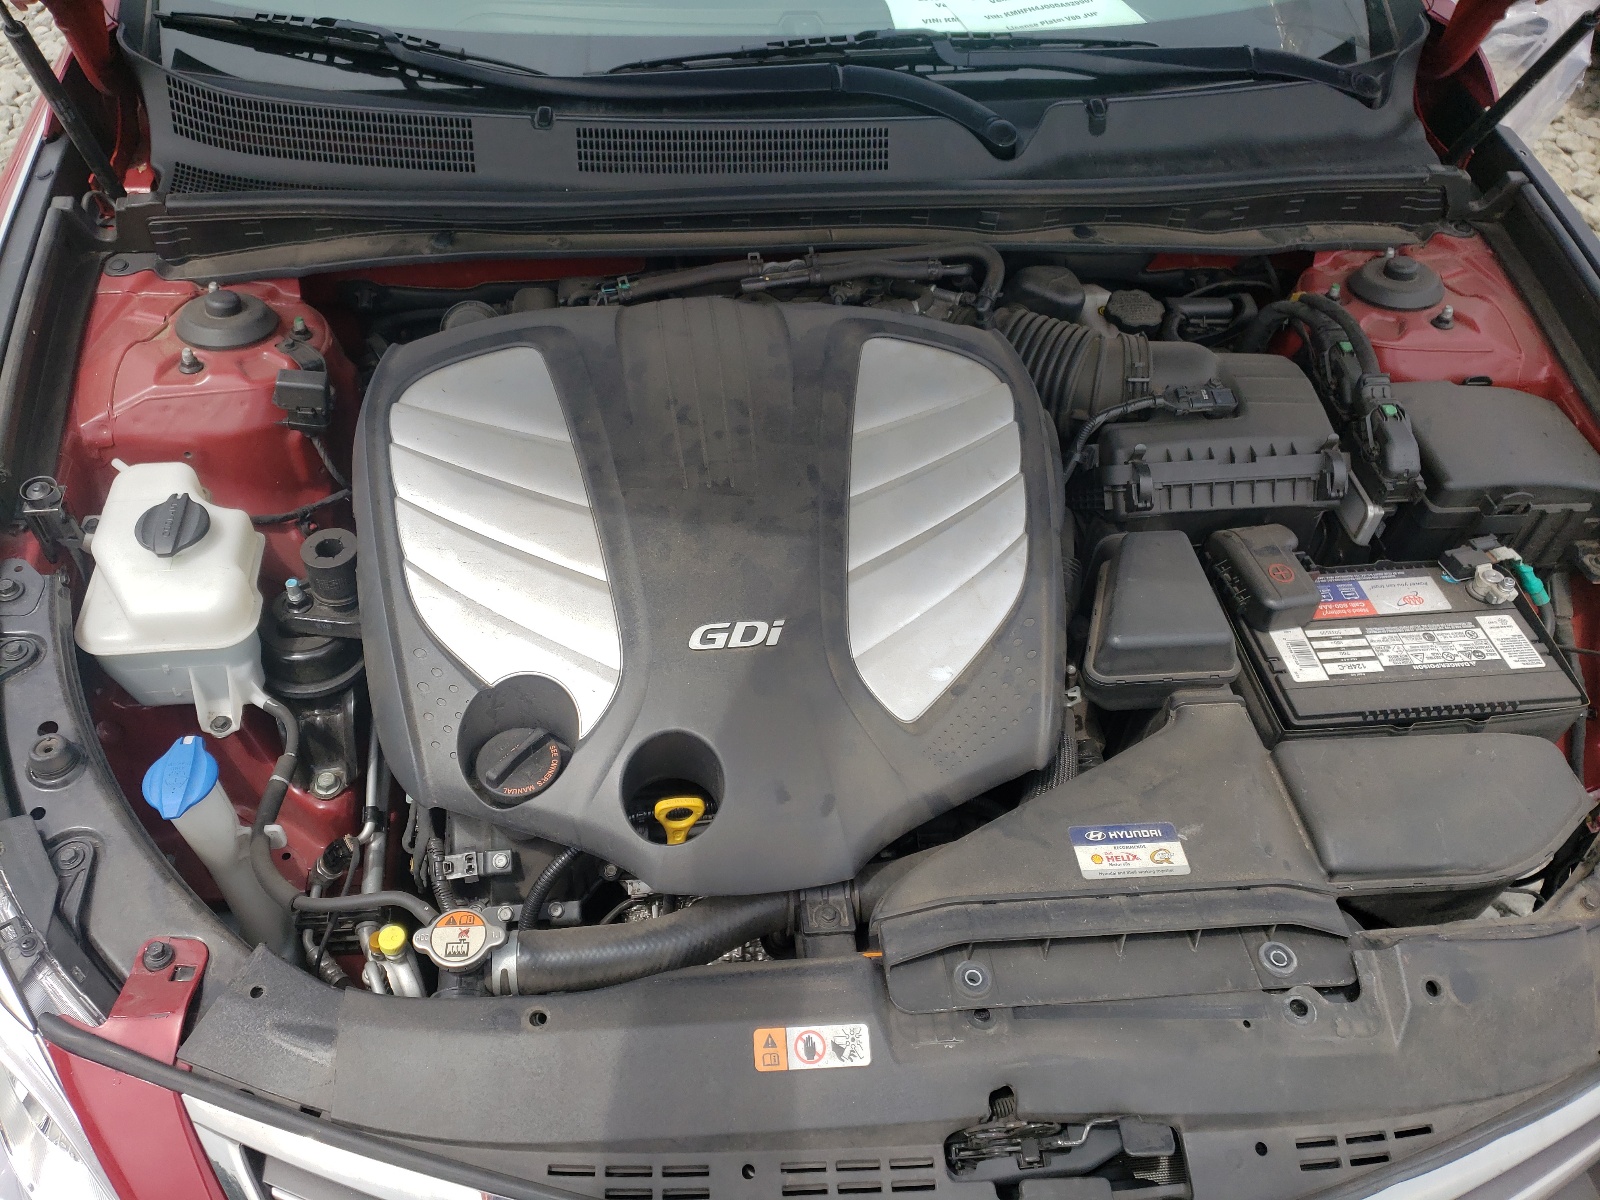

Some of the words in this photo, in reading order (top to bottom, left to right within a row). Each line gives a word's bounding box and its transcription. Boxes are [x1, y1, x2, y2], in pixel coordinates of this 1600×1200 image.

[688, 620, 785, 650] GDi
[1337, 663, 1367, 671] 124R-C
[503, 784, 536, 795] MANUAL
[1108, 829, 1162, 839] HYUNDAI
[1106, 853, 1140, 862] HELIX
